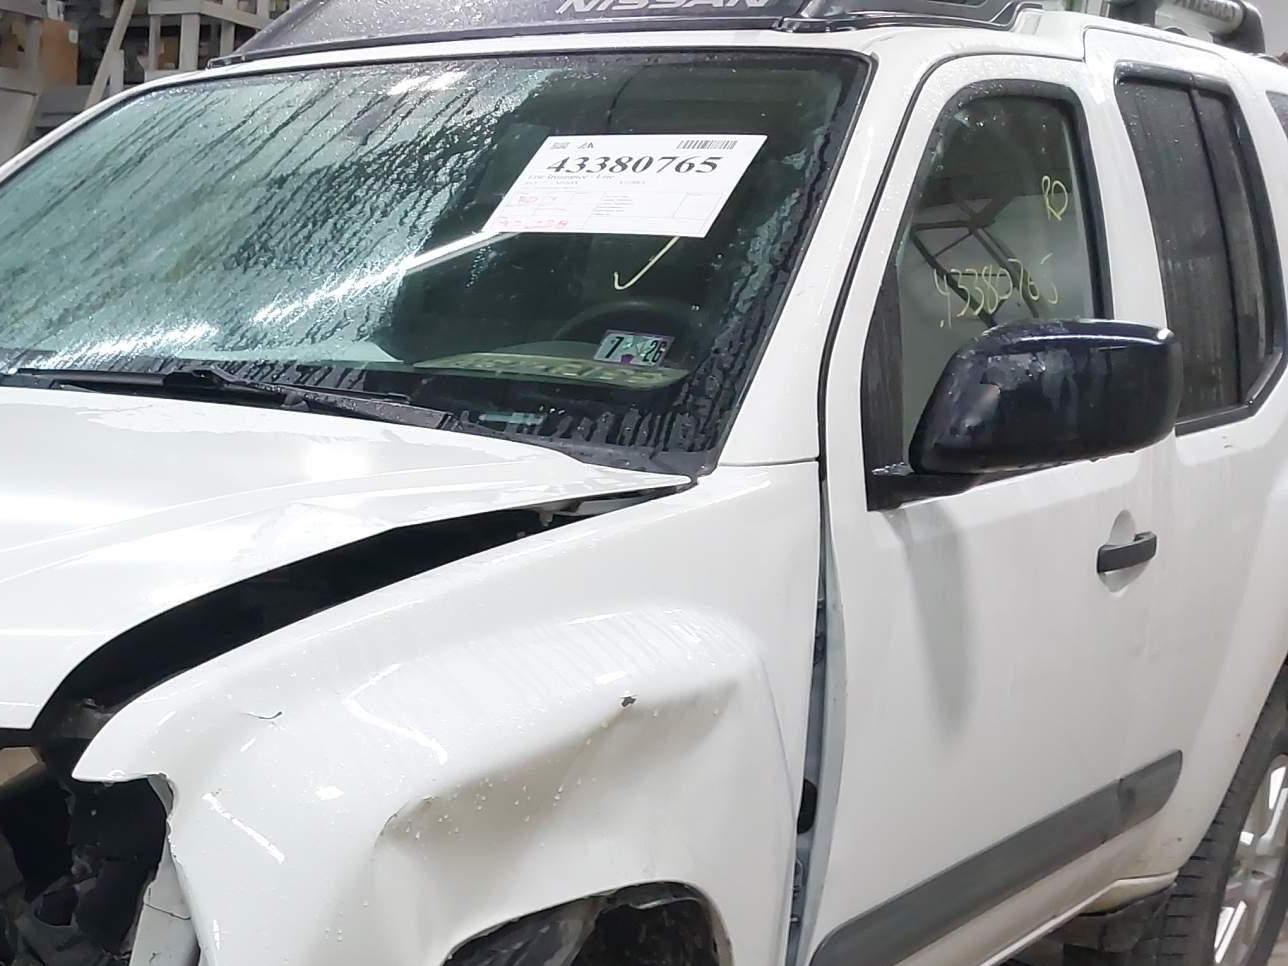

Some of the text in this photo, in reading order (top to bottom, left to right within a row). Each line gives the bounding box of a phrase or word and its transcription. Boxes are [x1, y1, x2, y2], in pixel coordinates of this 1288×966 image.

[547, 156, 722, 173] 43380765
[605, 336, 668, 363] 7 26
